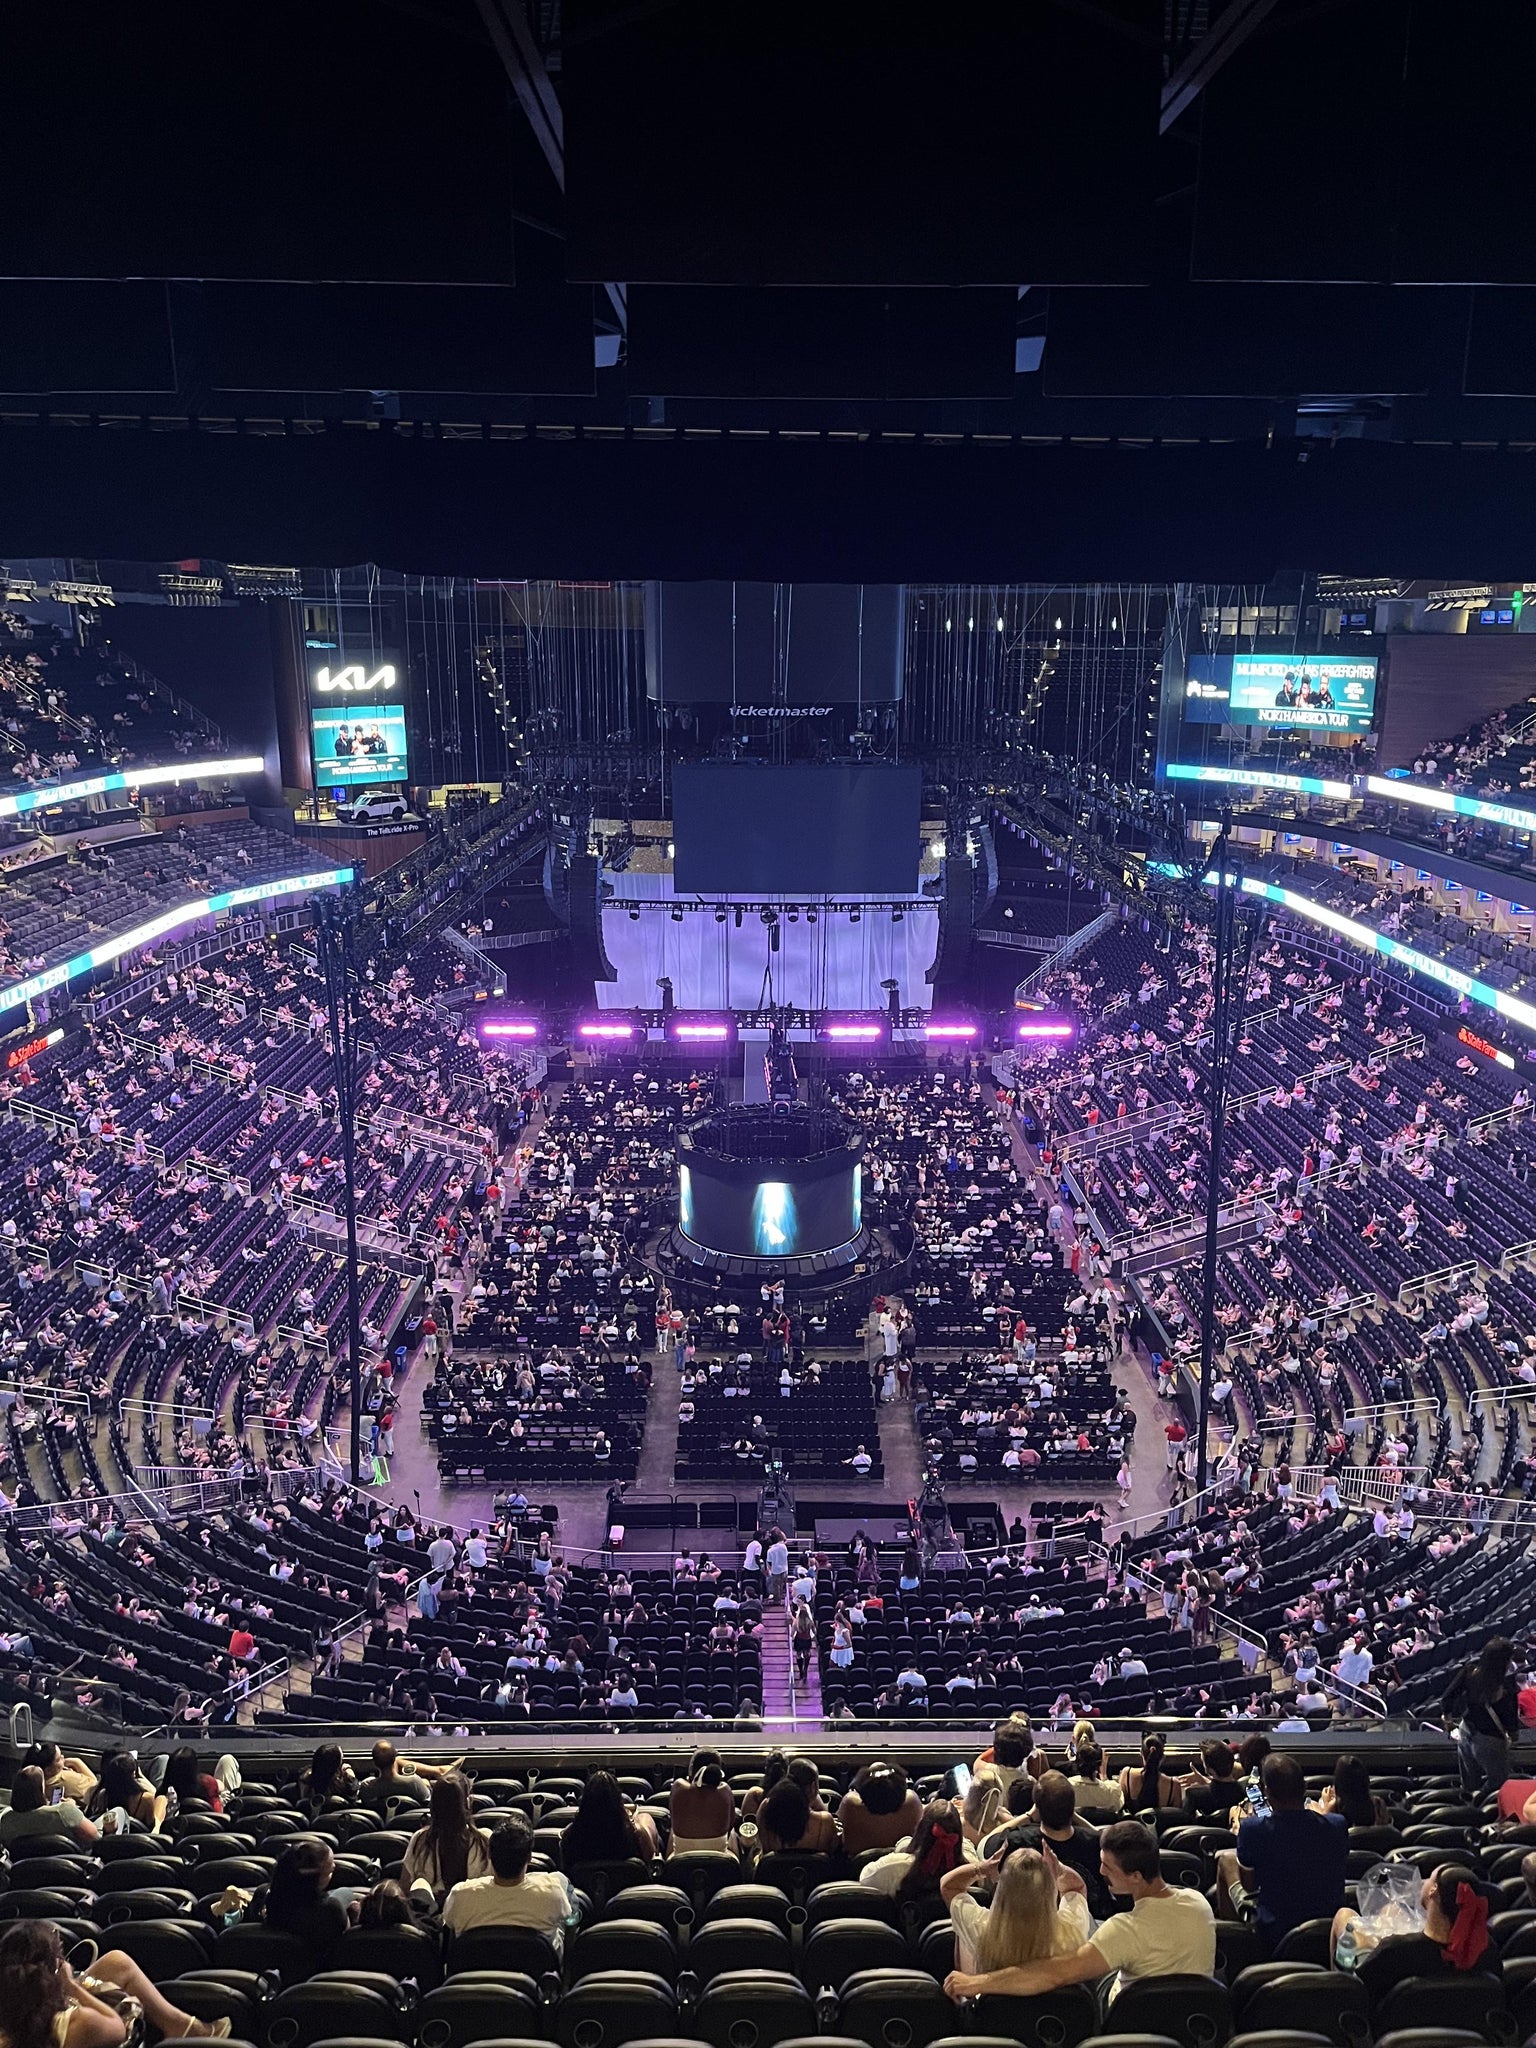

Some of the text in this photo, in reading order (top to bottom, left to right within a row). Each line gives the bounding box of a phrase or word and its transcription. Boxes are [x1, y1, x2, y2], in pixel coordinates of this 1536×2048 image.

[1236, 663, 1287, 676] MUMFORD
[317, 665, 396, 691] KIA
[1328, 713, 1349, 727] TOUR
[305, 872, 336, 888] ZERO
[44, 964, 70, 989] ZERO
